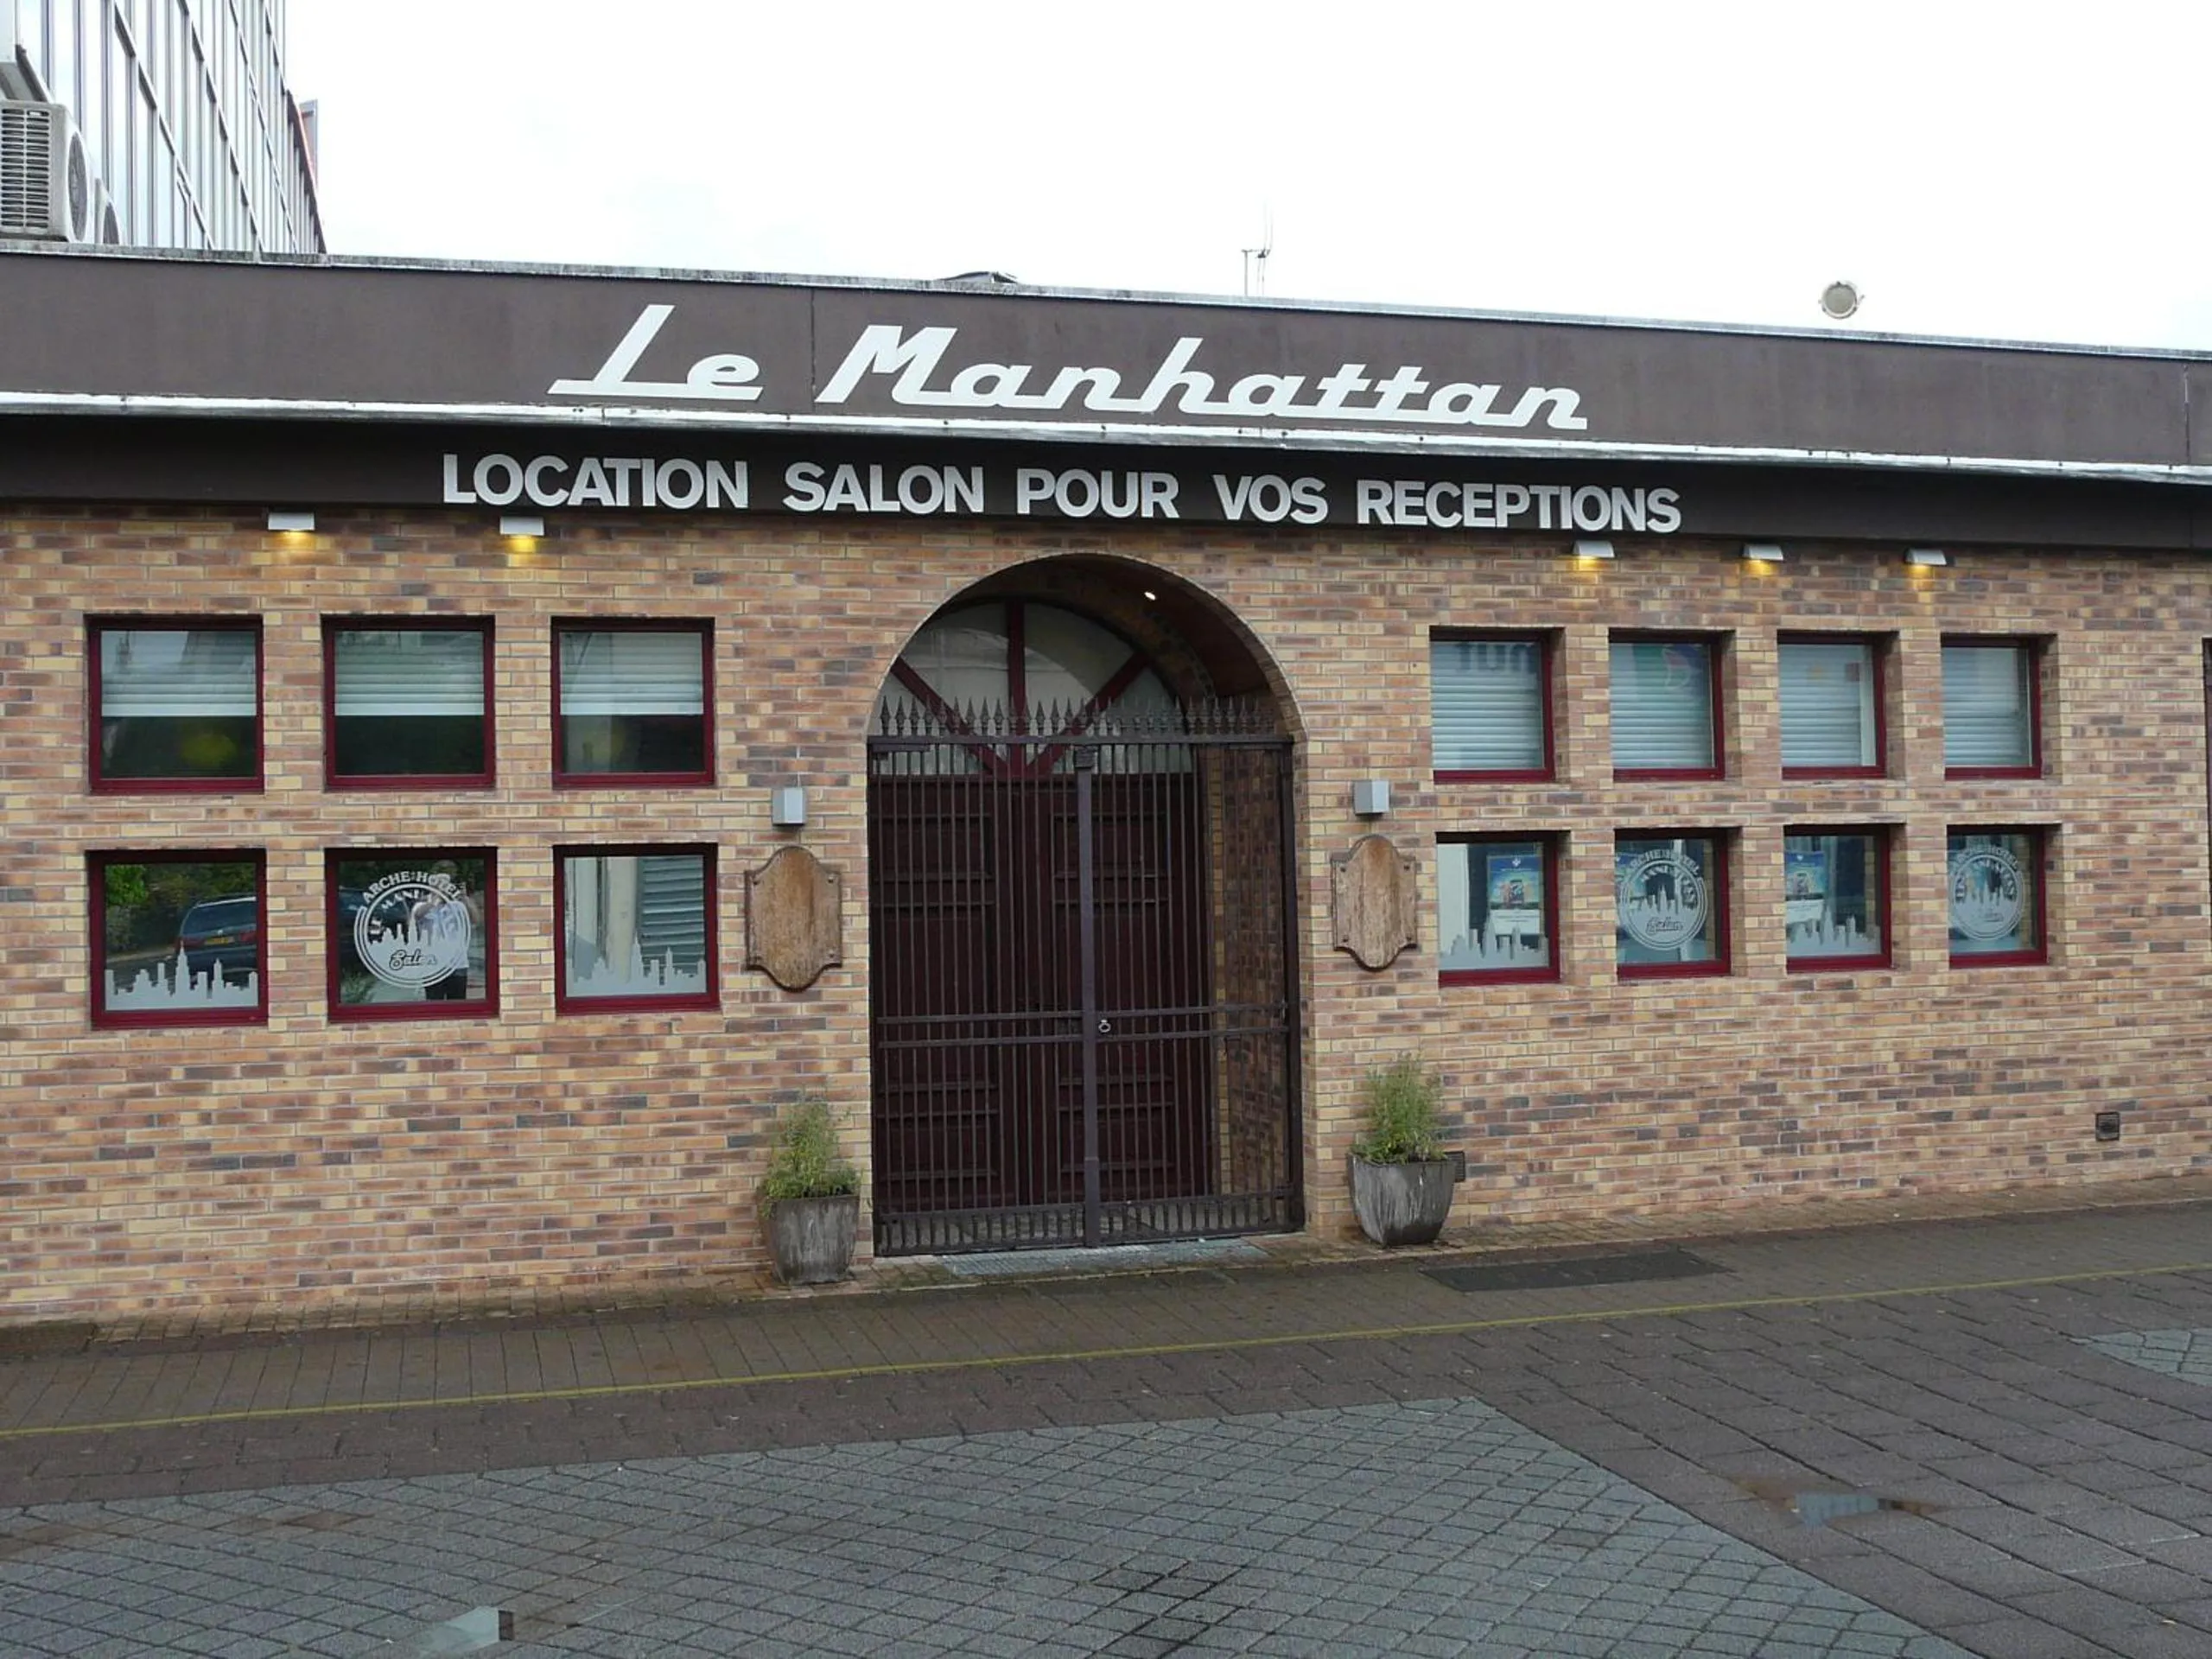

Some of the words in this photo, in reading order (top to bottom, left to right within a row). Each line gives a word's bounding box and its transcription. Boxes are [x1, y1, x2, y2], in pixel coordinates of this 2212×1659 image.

[546, 303, 764, 401] Le
[814, 324, 1588, 430] Manhattan
[442, 454, 749, 509] LOCATION
[783, 463, 985, 514] SALON
[1017, 469, 1180, 519] POUR
[1213, 475, 1329, 524] VOS
[1357, 480, 1682, 533] RECEPTIONS
[362, 870, 411, 905] ARCHE
[416, 870, 462, 901] HOTEL
